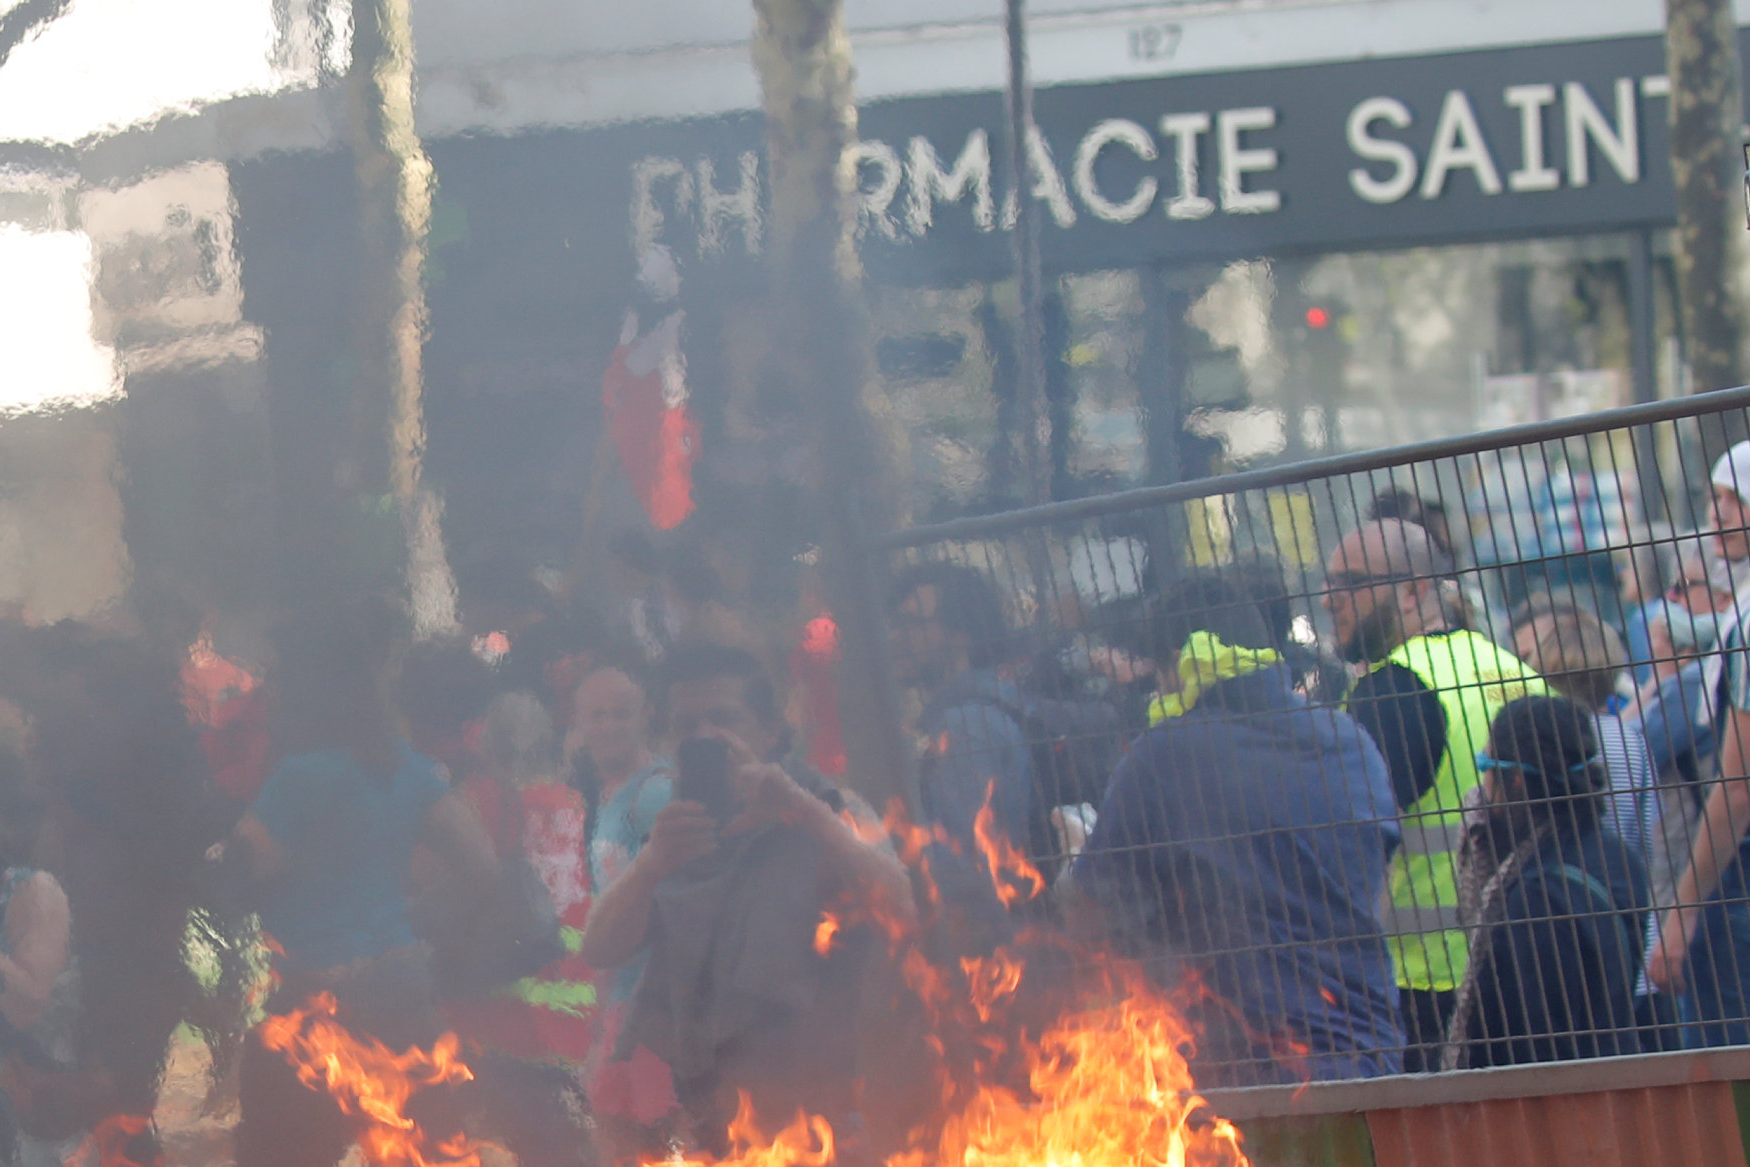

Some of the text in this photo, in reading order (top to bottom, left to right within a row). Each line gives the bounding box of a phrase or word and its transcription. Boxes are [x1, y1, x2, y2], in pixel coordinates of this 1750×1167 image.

[1128, 23, 1183, 60] 127
[630, 75, 1672, 258] PHRMACIE SAIN
